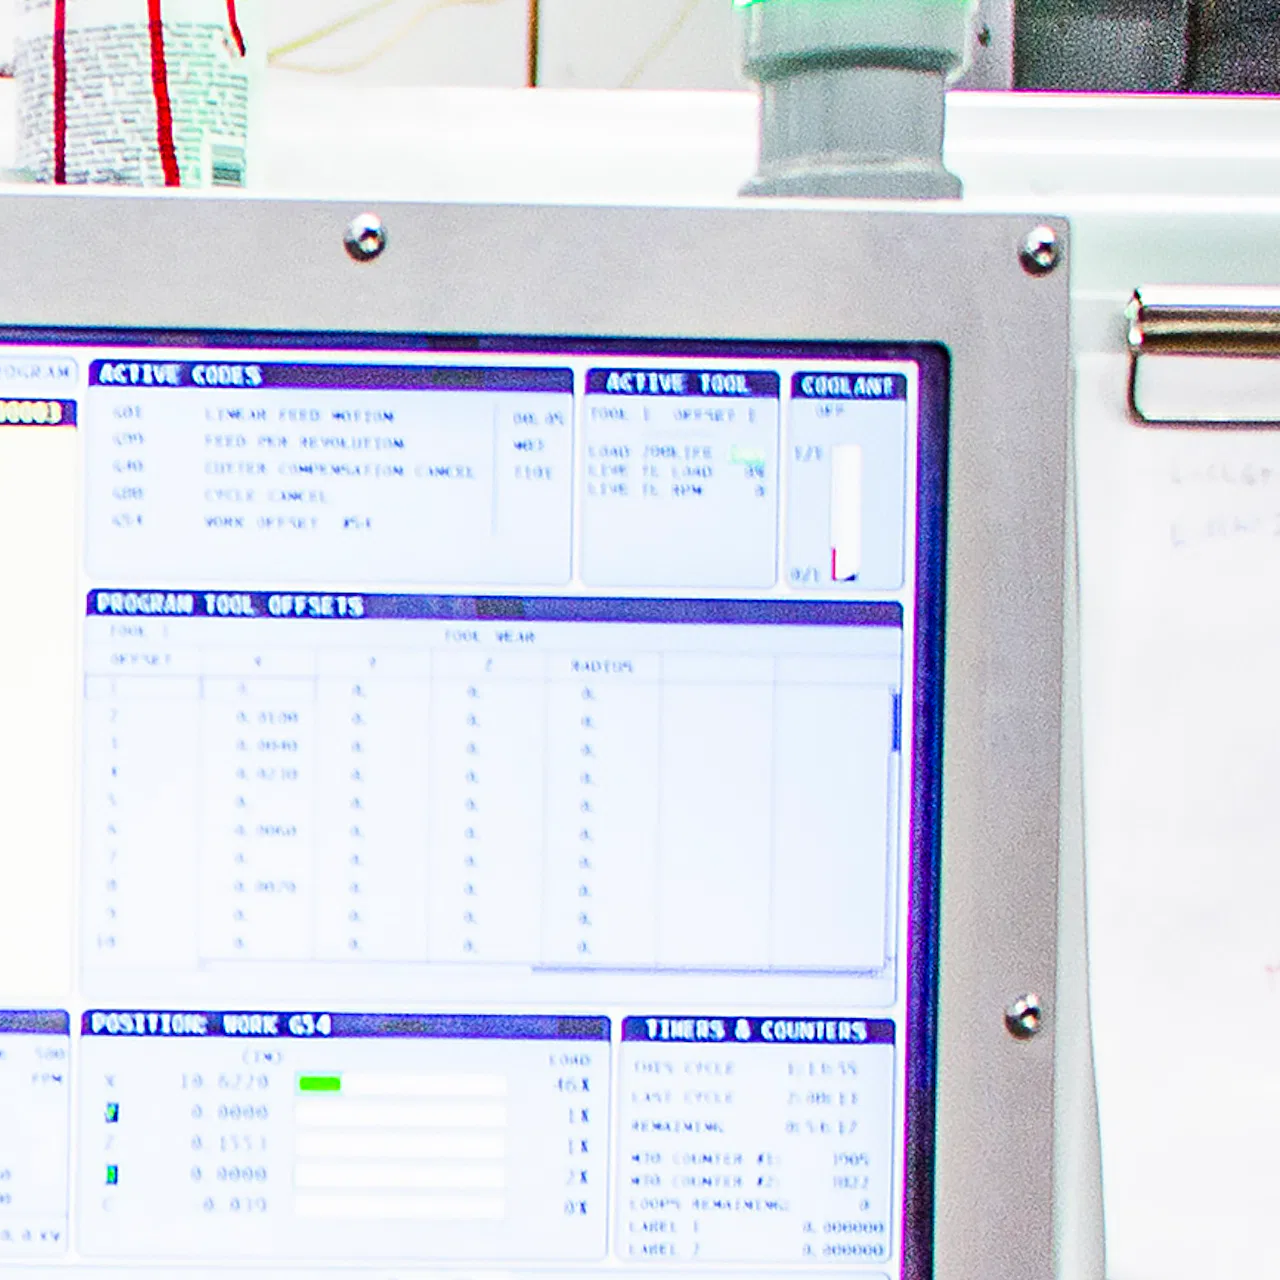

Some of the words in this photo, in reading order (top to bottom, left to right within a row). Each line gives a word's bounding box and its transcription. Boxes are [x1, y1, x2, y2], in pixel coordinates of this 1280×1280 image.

[98, 363, 182, 386] ACTIVE
[191, 365, 264, 387] CODES
[605, 372, 688, 393] ACTIVE
[699, 373, 752, 394] TOOL
[801, 376, 895, 396] COOLANT
[97, 592, 195, 615] PROGRAM
[203, 593, 257, 616] TOOL
[268, 594, 365, 617] OFFSETS
[222, 1014, 279, 1036] WORK
[645, 1018, 726, 1041] TIMERS
[759, 1021, 868, 1042] COUNTERS
